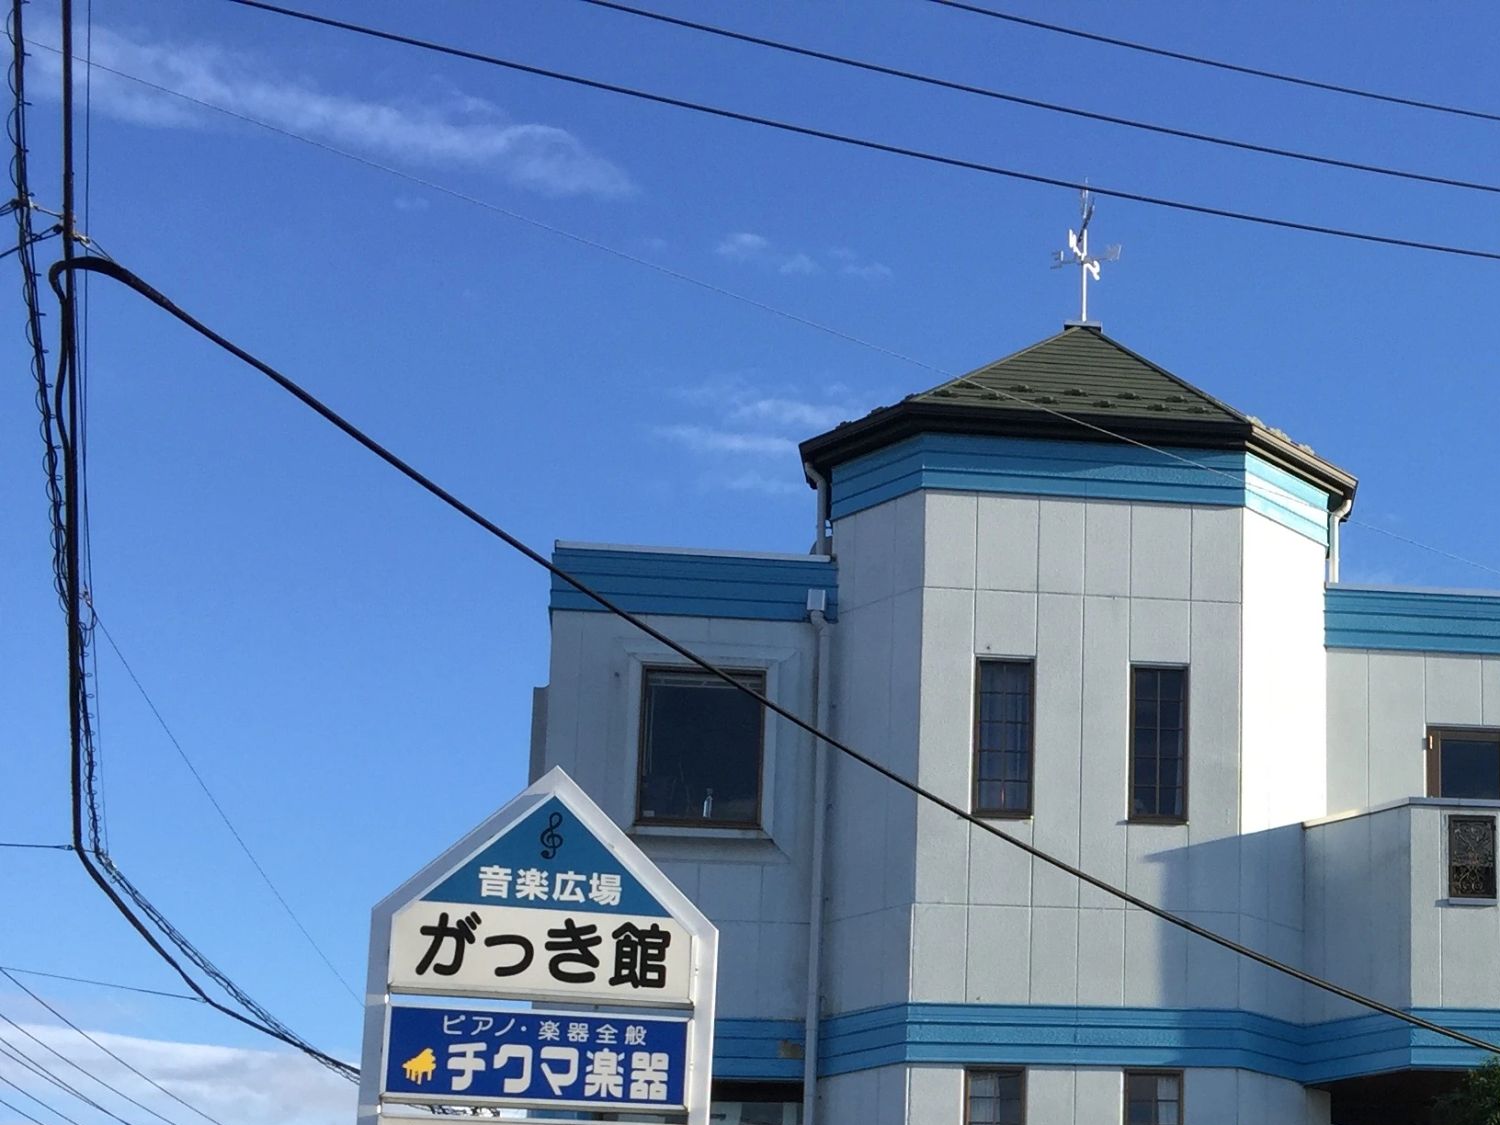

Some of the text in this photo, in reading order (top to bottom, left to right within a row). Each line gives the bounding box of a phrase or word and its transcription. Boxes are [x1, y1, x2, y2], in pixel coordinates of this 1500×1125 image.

[478, 864, 623, 906] 音楽広場
[415, 911, 671, 989] がっき館
[443, 1014, 647, 1045] ピアノ・楽器全般
[446, 1041, 669, 1101] チクマ楽器
